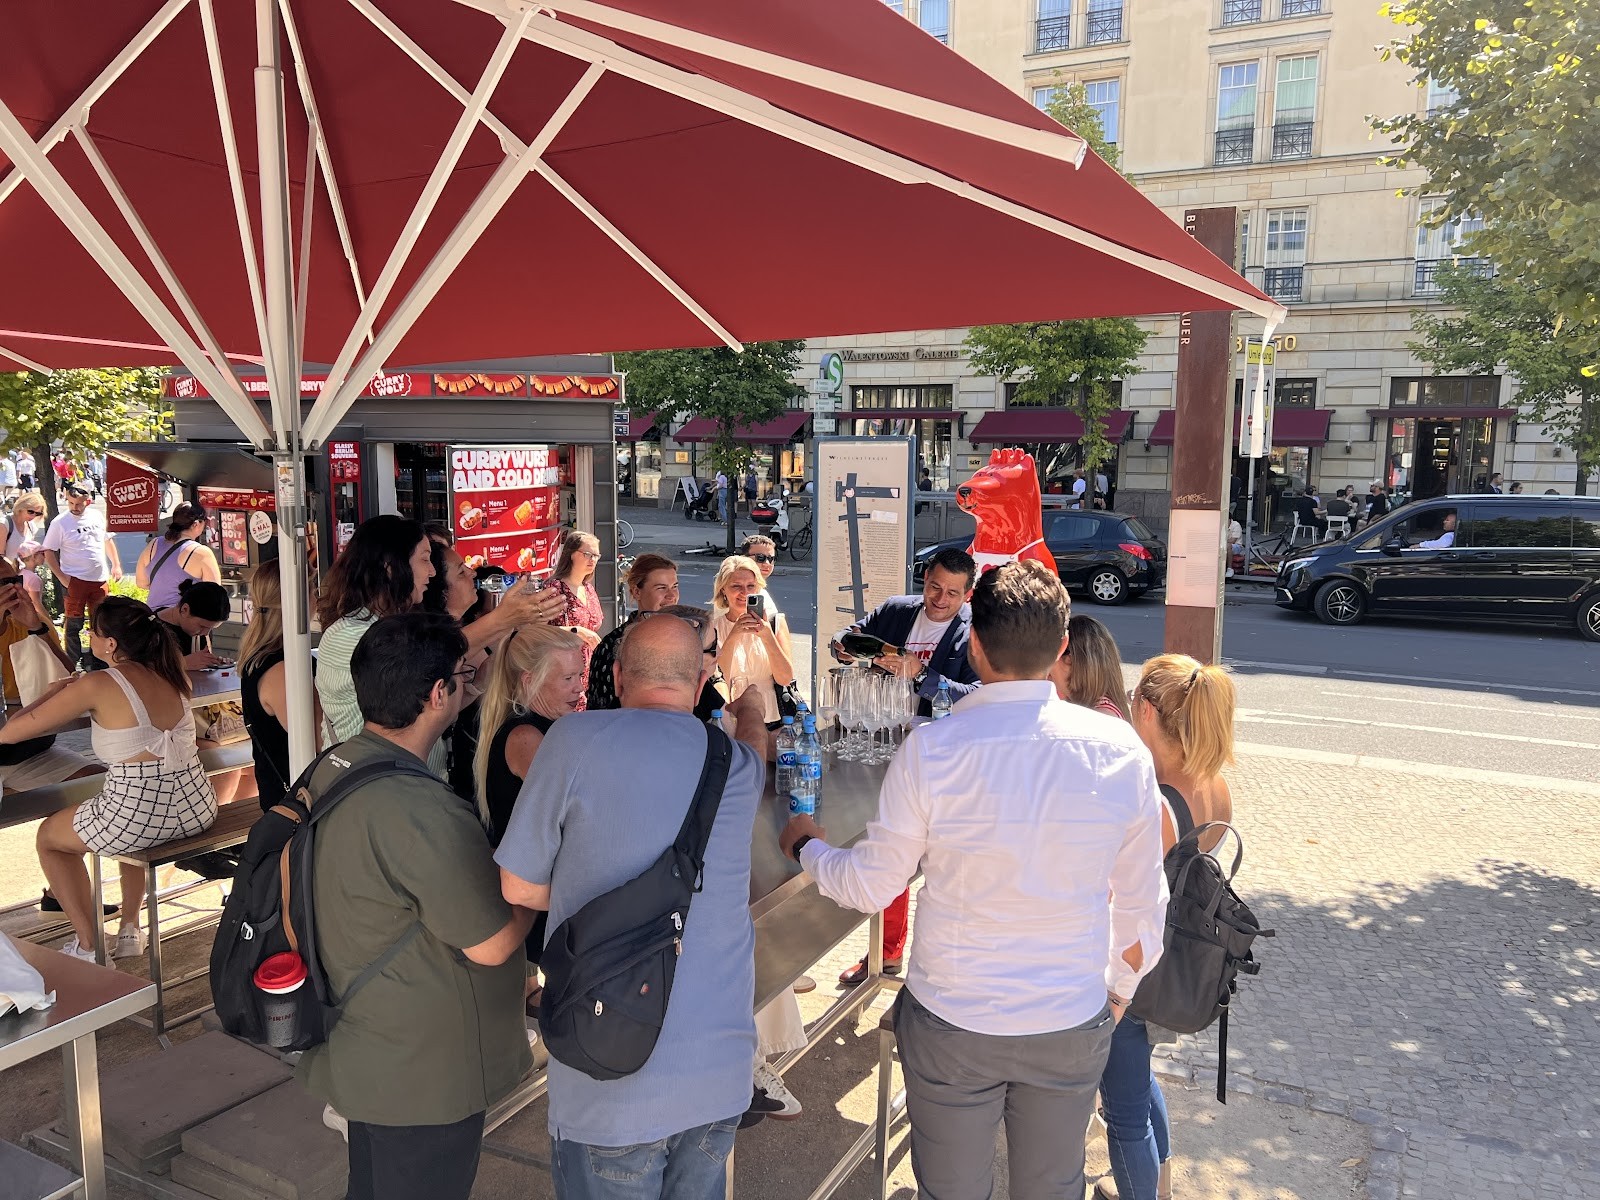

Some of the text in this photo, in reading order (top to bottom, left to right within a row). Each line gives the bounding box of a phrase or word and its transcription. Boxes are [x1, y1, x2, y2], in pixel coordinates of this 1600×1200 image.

[915, 348, 959, 359] GALERIE
[177, 377, 193, 390] CURRY
[374, 374, 404, 389] CURRY
[178, 385, 193, 397] WOLF
[377, 383, 404, 396] WOLF
[451, 449, 550, 470] CURRYWURST
[453, 469, 495, 490] AND
[496, 468, 533, 488] COLD
[113, 481, 148, 496] CURRY
[116, 489, 148, 503] WOLF
[488, 500, 504, 508] Menu
[221, 512, 237, 522] HOT
[257, 522, 271, 531] MAL
[489, 545, 505, 553] Menu
